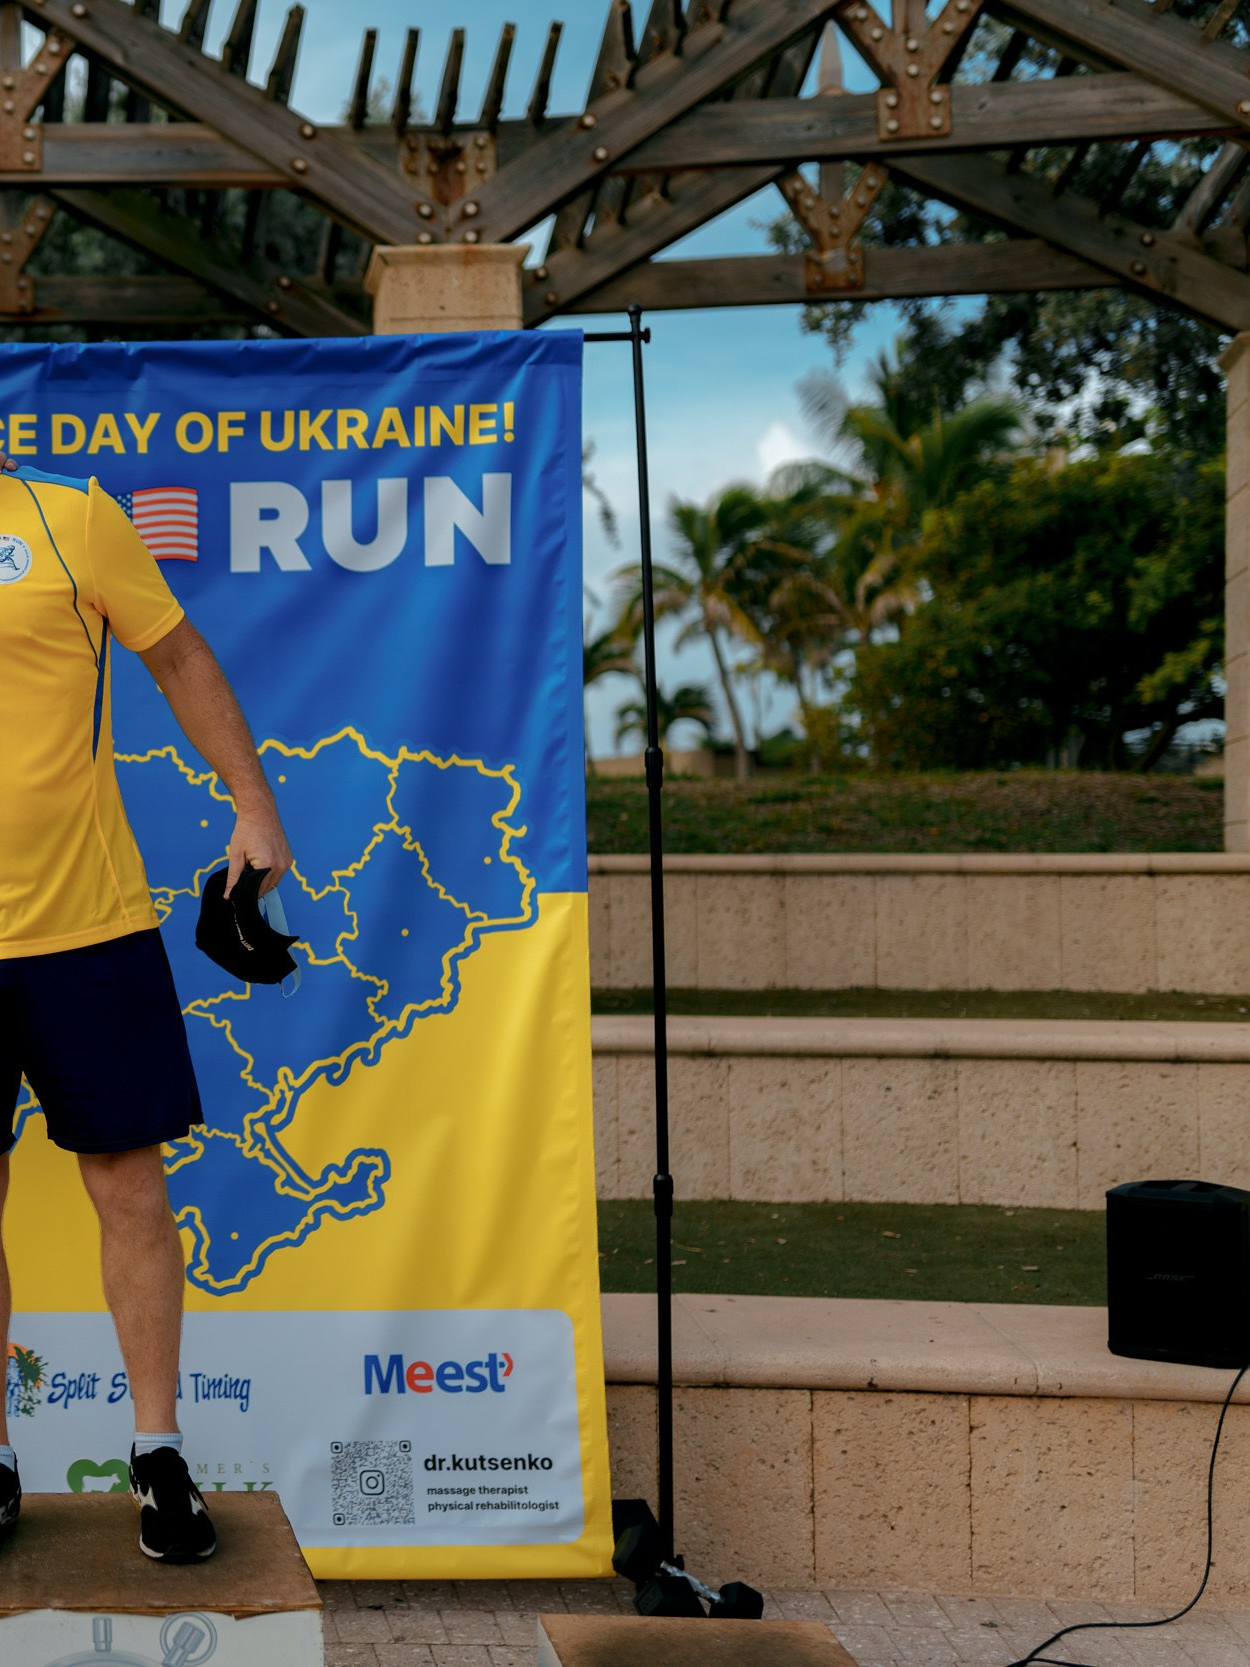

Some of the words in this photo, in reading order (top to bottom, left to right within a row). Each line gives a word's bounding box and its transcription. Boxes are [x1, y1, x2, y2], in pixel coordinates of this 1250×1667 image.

[51, 412, 161, 454] DAY
[175, 411, 245, 453] OF
[259, 401, 516, 450] UKRAINE!
[230, 472, 512, 572] RUN
[12, 537, 24, 546] RUN
[364, 1352, 507, 1394] Meest
[47, 1371, 101, 1409] Split
[189, 1373, 251, 1412] Timing
[196, 1460, 270, 1474] MER'S
[424, 1453, 553, 1471] dr.kutsenko
[427, 1486, 476, 1497] massage
[478, 1484, 529, 1497] therapist
[428, 1501, 473, 1513] physical
[475, 1500, 560, 1512] rehabilitologist
